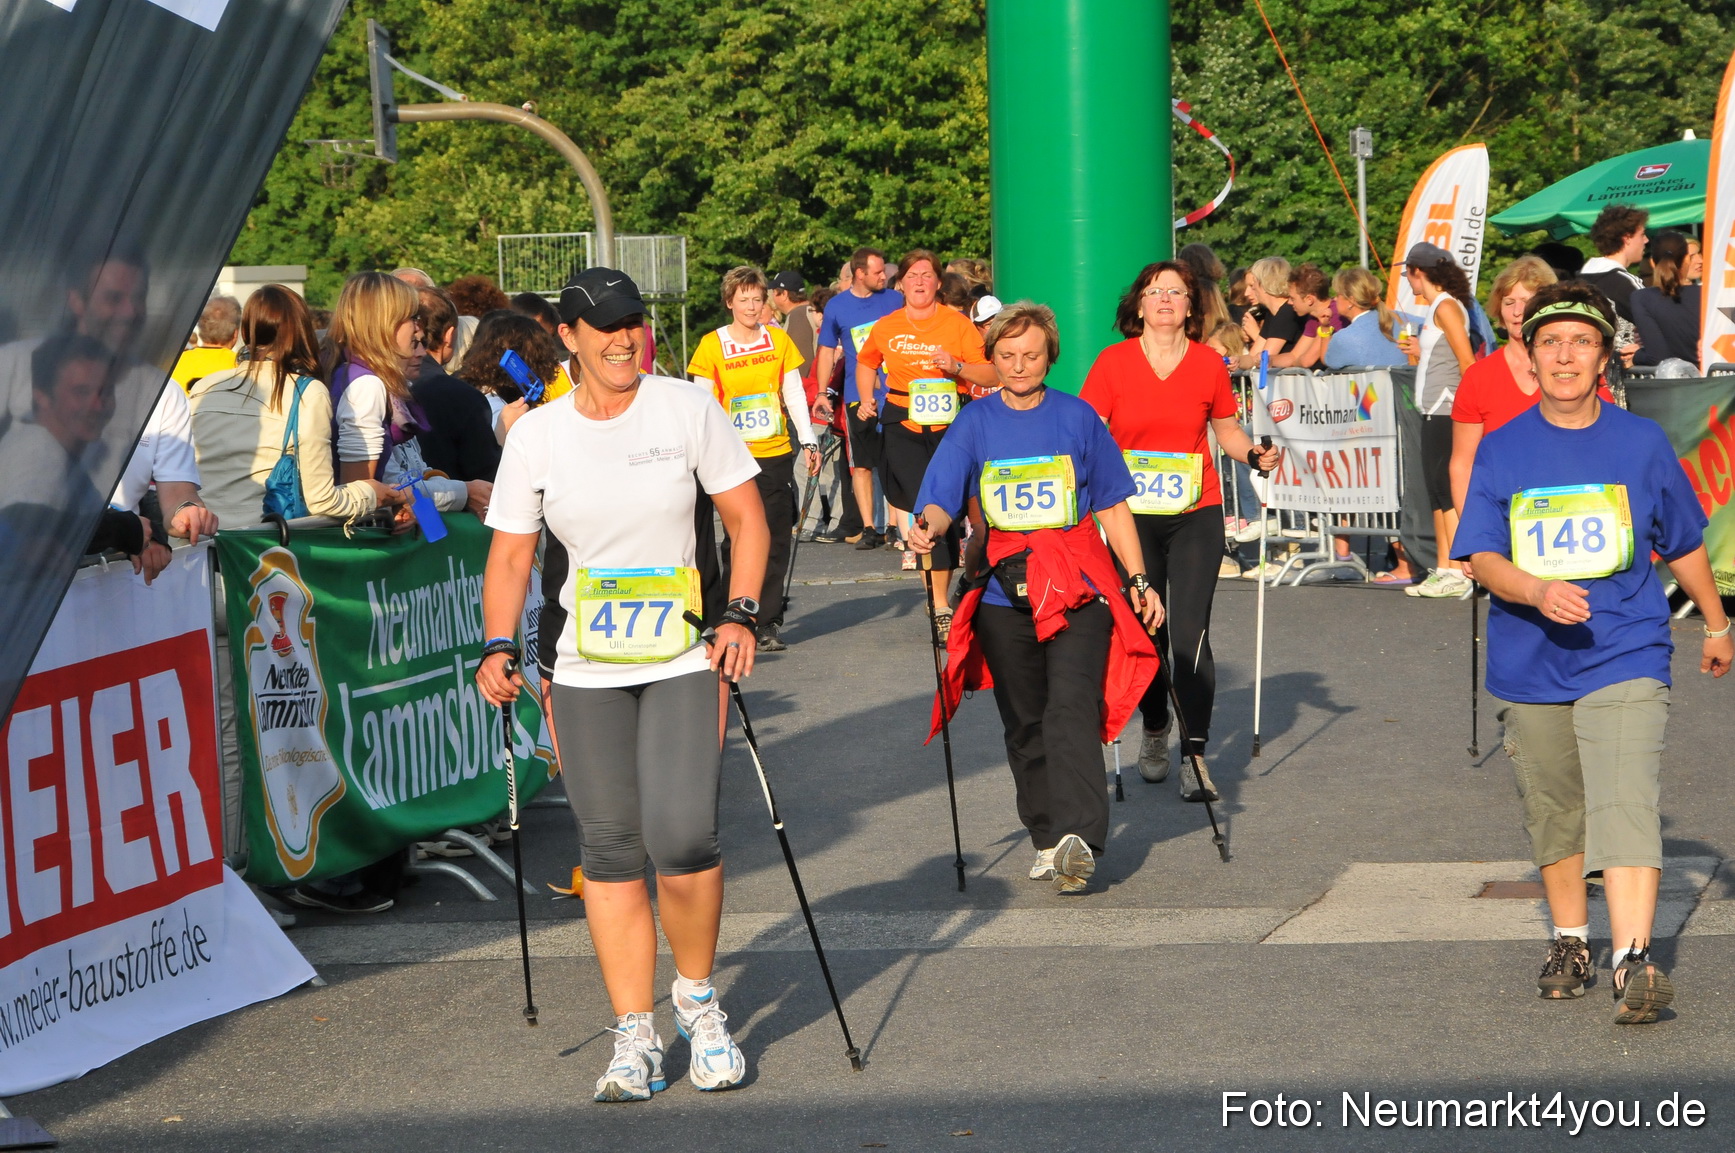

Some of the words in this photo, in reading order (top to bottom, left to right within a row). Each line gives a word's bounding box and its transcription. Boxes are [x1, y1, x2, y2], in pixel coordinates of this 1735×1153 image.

[1586, 181, 1696, 202] Lammsbräu
[1605, 177, 1686, 192] Neumarkter
[725, 360, 749, 371] MAX
[752, 354, 779, 366] BÖGL
[914, 394, 953, 413] 983
[733, 409, 770, 430] 458
[1132, 472, 1183, 499] 643
[993, 481, 1056, 512] 155
[1007, 512, 1028, 521] Birgit
[1527, 517, 1606, 557] 148
[1543, 558, 1564, 567] Inge
[593, 587, 632, 596] firmenlauf
[589, 601, 674, 638] 477
[609, 641, 625, 649] Ulli
[0, 668, 214, 940] EIER
[0, 908, 211, 1053] w.meier-baustoffe.de
